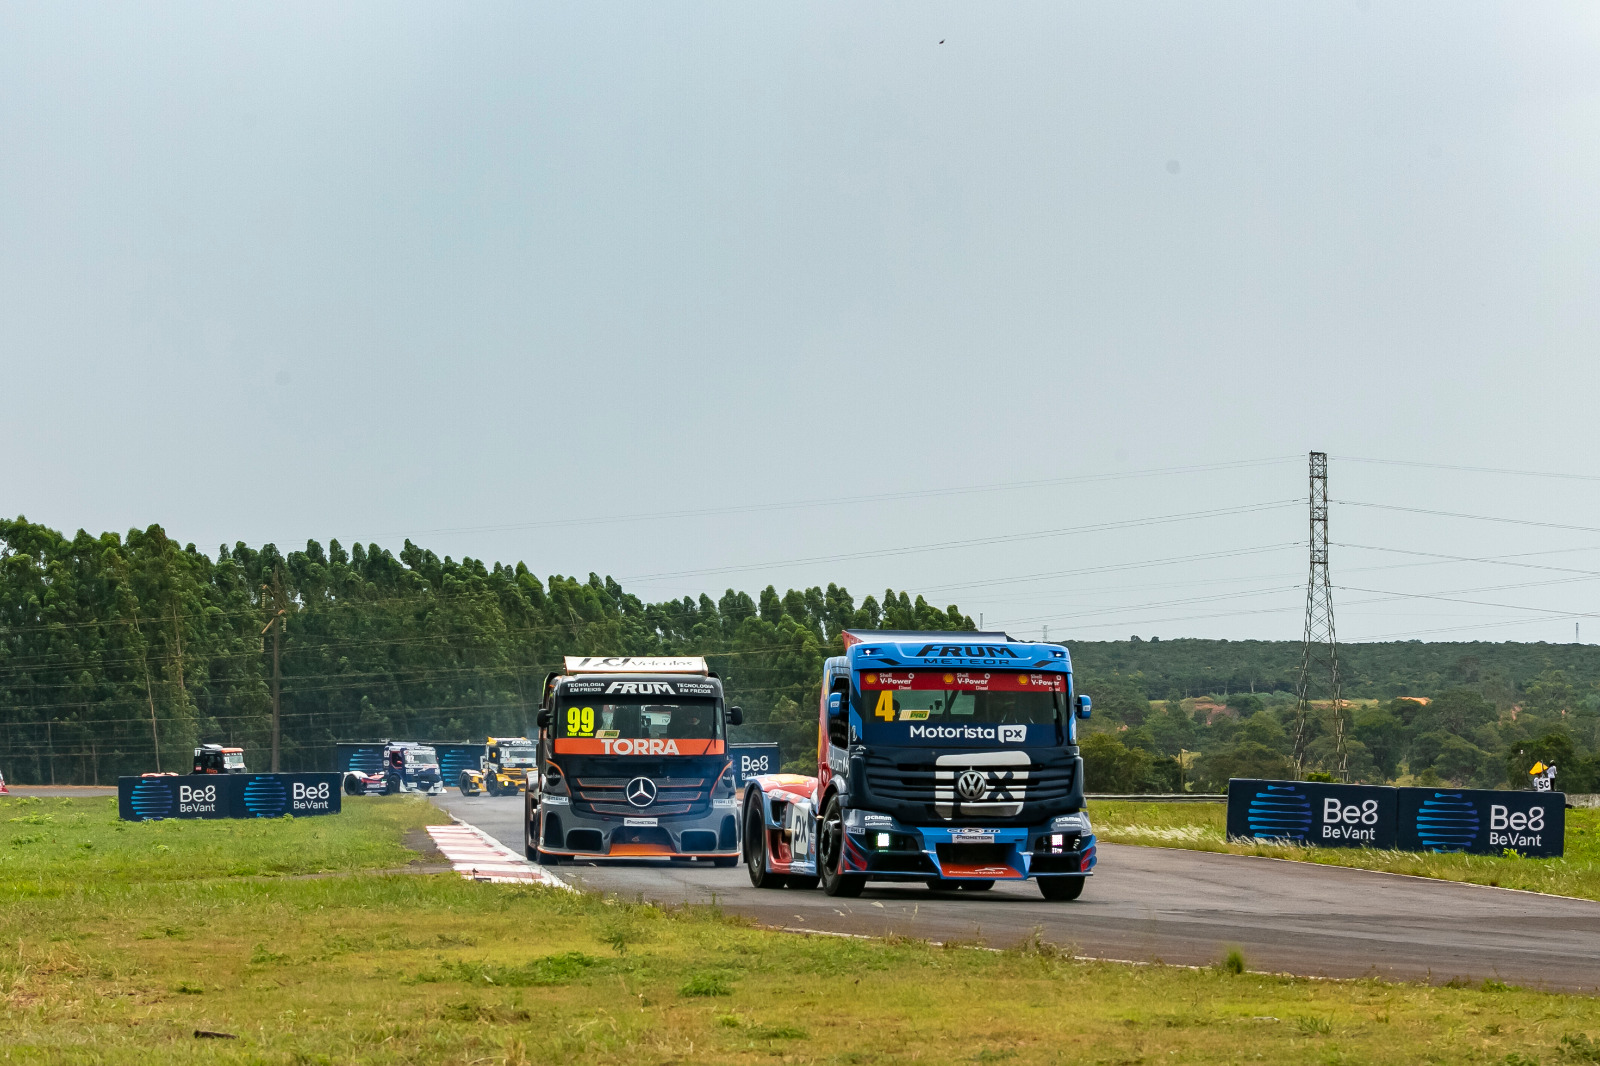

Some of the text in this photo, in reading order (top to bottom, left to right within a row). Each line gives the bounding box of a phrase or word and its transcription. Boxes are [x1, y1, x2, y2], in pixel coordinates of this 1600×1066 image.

[916, 644, 1018, 658] FRUM
[605, 682, 676, 694] FRUM
[875, 690, 895, 721] 4
[567, 707, 594, 732] 99
[910, 725, 1022, 741] Motorista px
[601, 739, 679, 755] TORRA
[741, 755, 768, 771] Be8
[293, 782, 329, 800] Be8
[1538, 780, 1549, 789] SC
[179, 785, 216, 802] Be8
[180, 804, 215, 812] BeVant
[293, 801, 328, 809] BeVant
[1323, 798, 1378, 824] Be8
[1490, 804, 1545, 832] Be8
[1322, 825, 1376, 840] BeVant
[1489, 832, 1542, 847] BeVant
